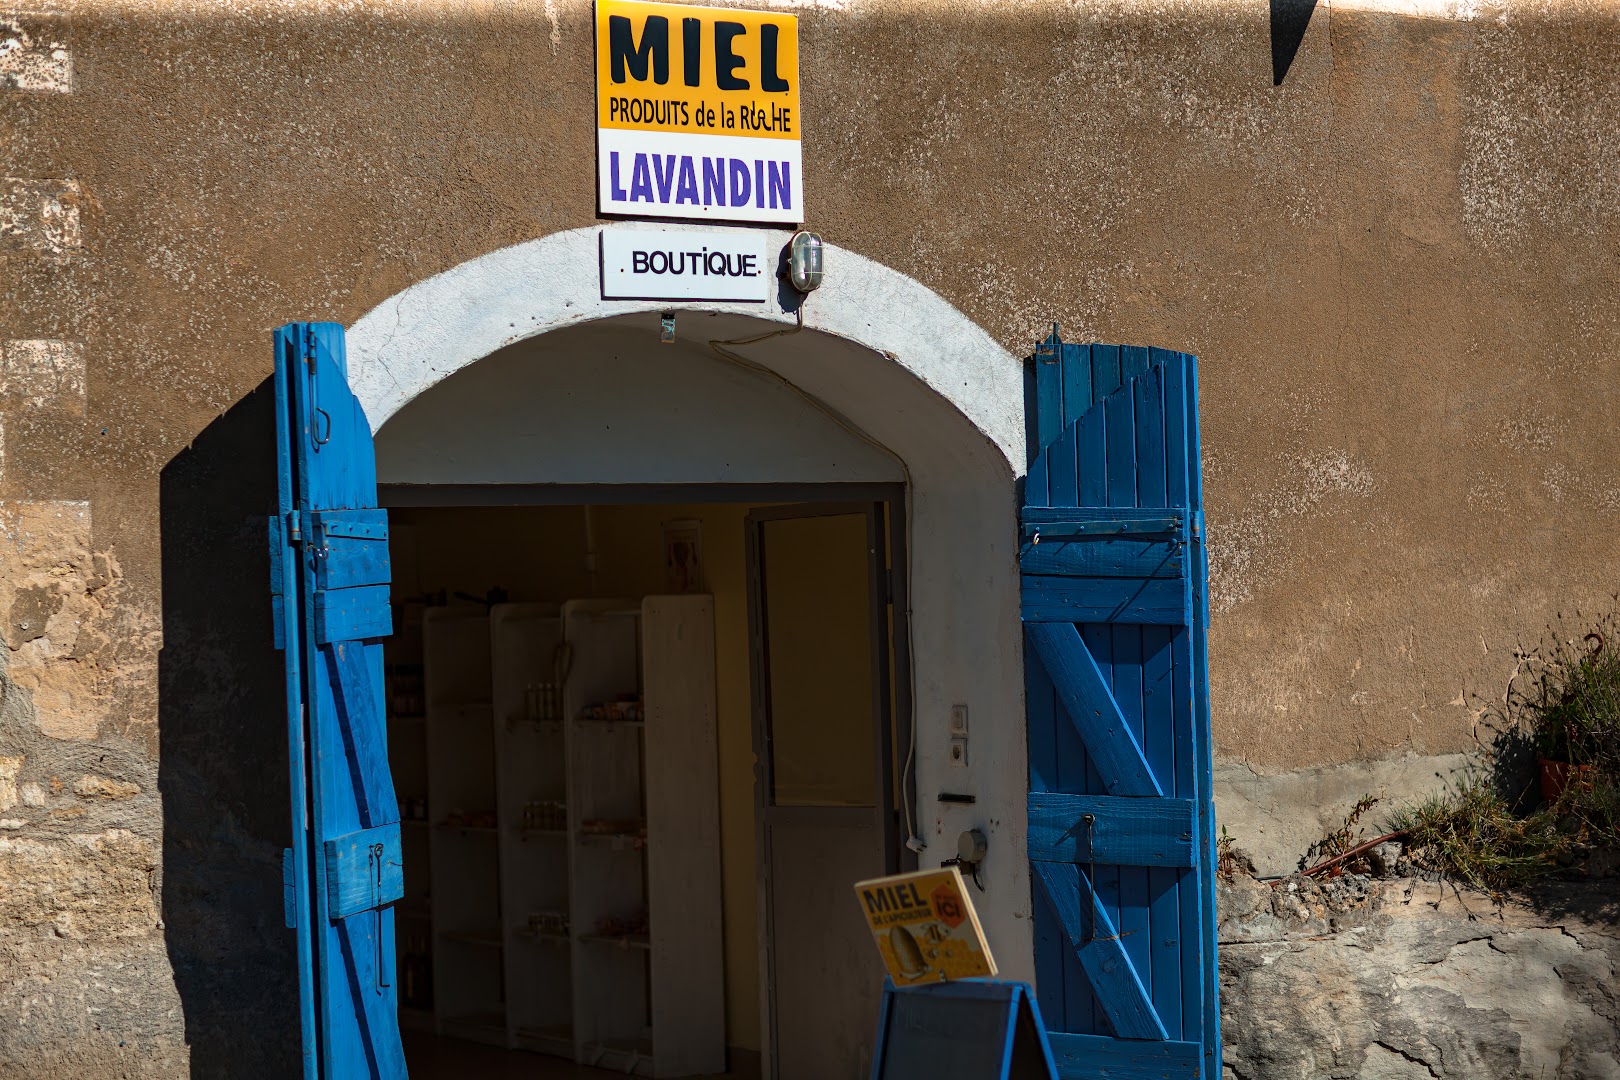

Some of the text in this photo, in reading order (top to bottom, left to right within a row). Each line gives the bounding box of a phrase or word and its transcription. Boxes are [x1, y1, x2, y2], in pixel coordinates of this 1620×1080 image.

[609, 15, 790, 92] MIEL
[610, 97, 689, 126] PRODUITS
[695, 101, 716, 127] de
[721, 102, 735, 129] la
[610, 151, 792, 210] LAVANDIN
[863, 882, 928, 914] MIEL
[935, 900, 961, 918] ICI
